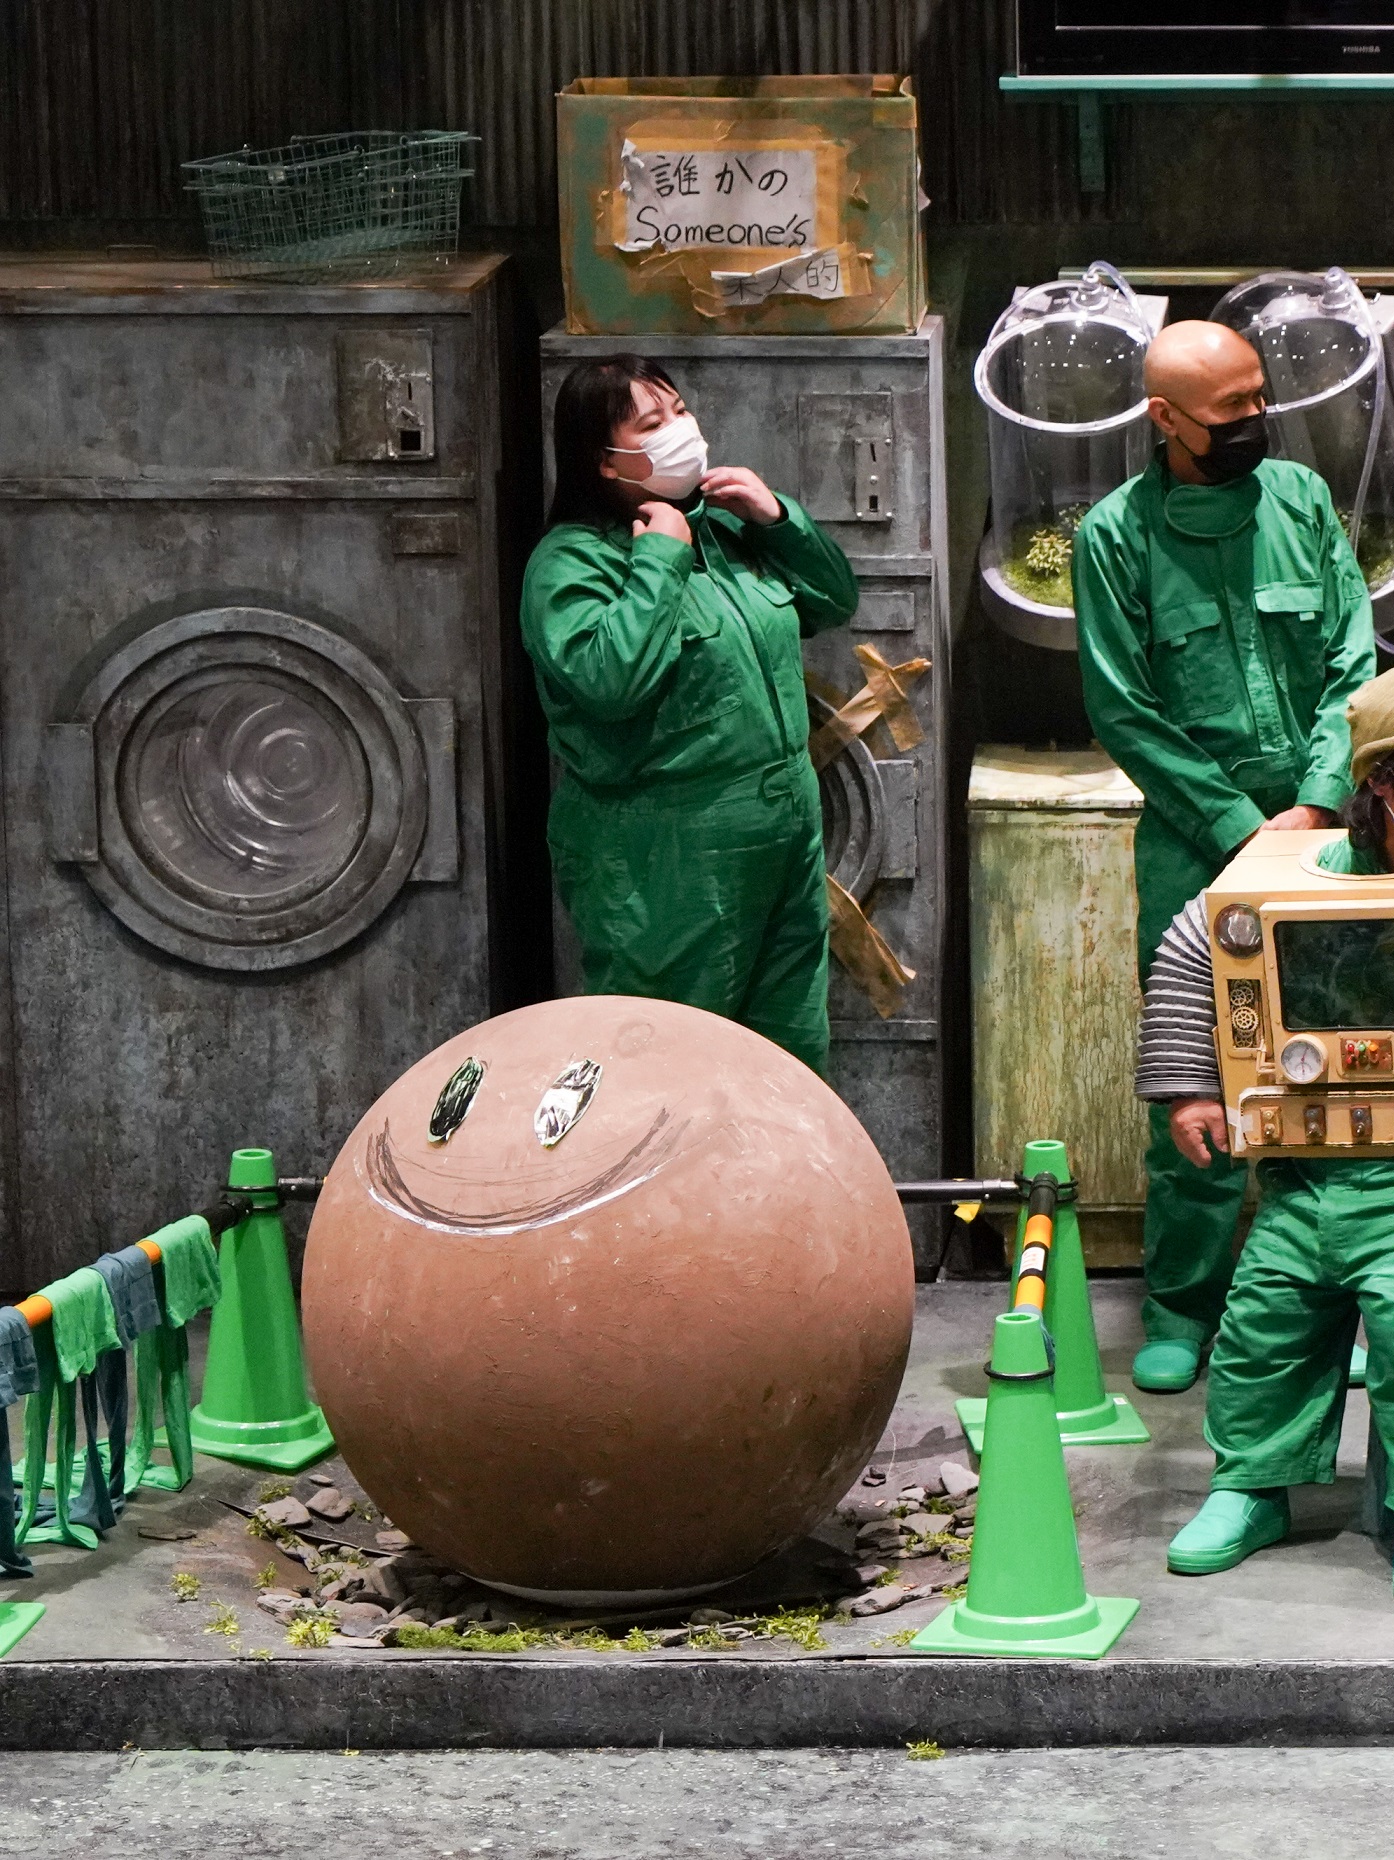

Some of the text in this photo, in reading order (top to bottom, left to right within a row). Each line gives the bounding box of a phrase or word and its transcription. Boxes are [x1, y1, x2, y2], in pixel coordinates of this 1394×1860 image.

[650, 154, 788, 198] 誰かの
[634, 205, 811, 249] Someone's
